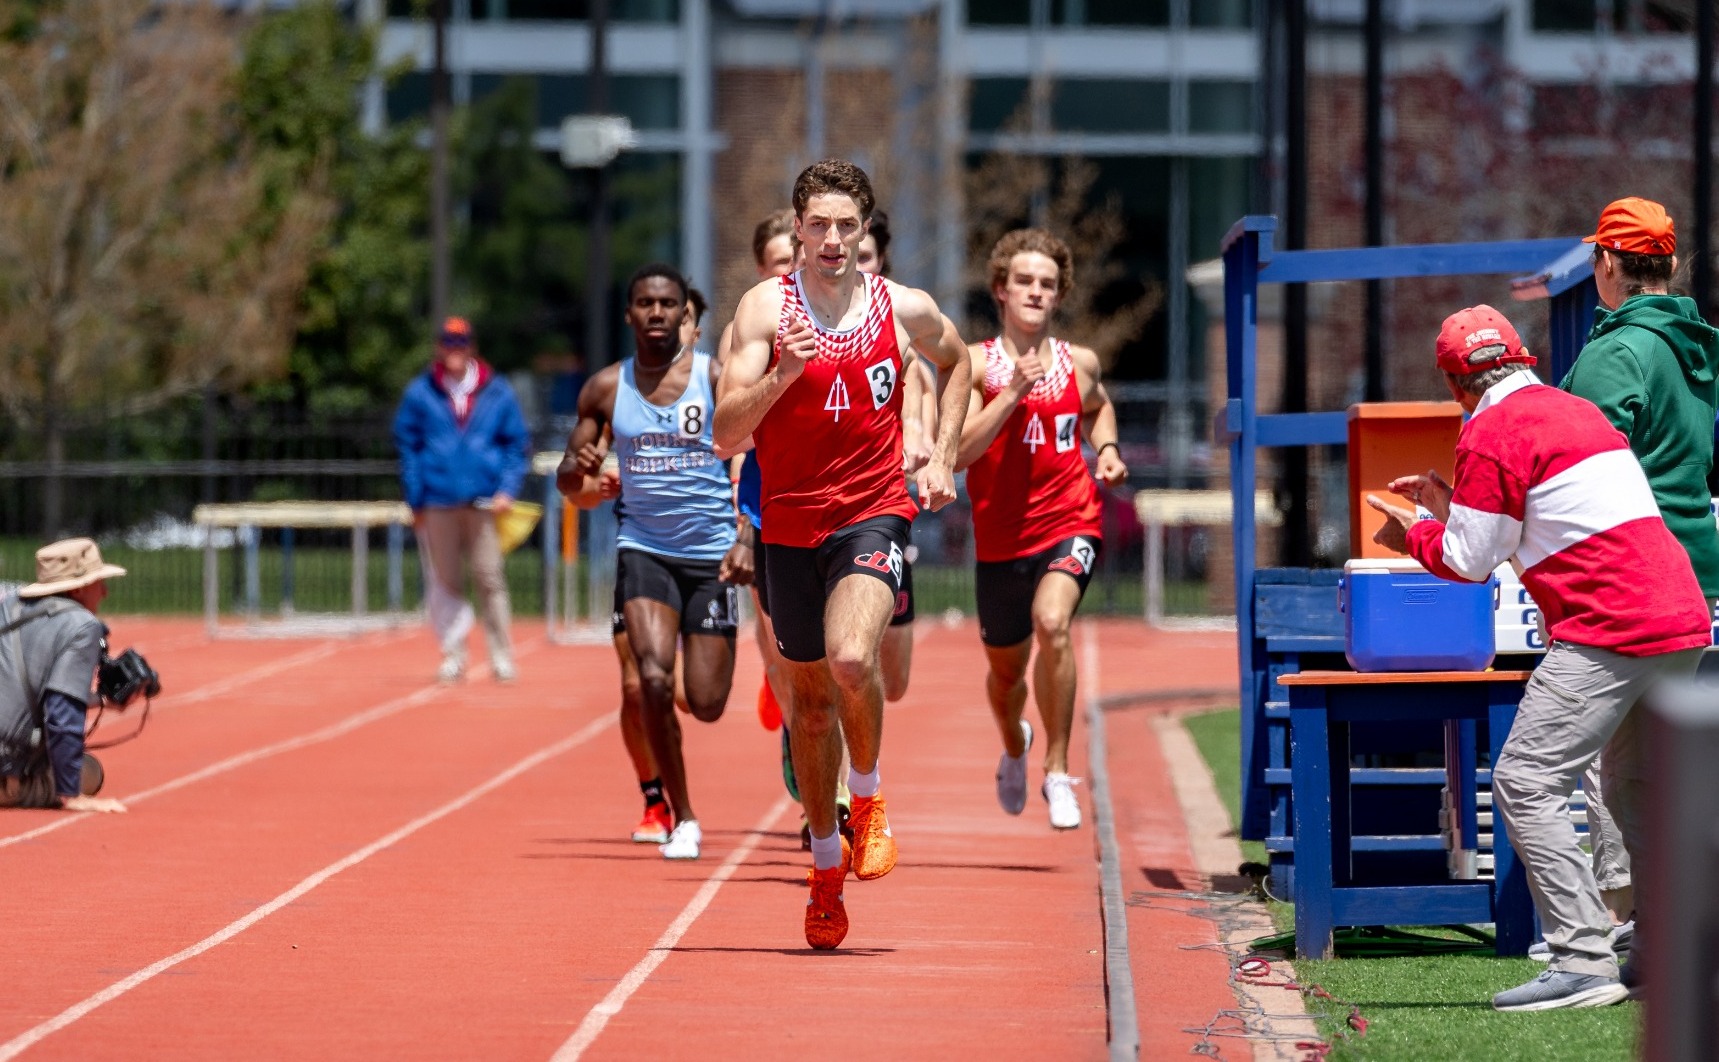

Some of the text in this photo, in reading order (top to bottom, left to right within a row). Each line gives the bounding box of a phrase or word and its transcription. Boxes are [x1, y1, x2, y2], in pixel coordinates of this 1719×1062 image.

[872, 365, 893, 404] 3
[685, 405, 701, 435] 8
[1059, 417, 1074, 448] 4
